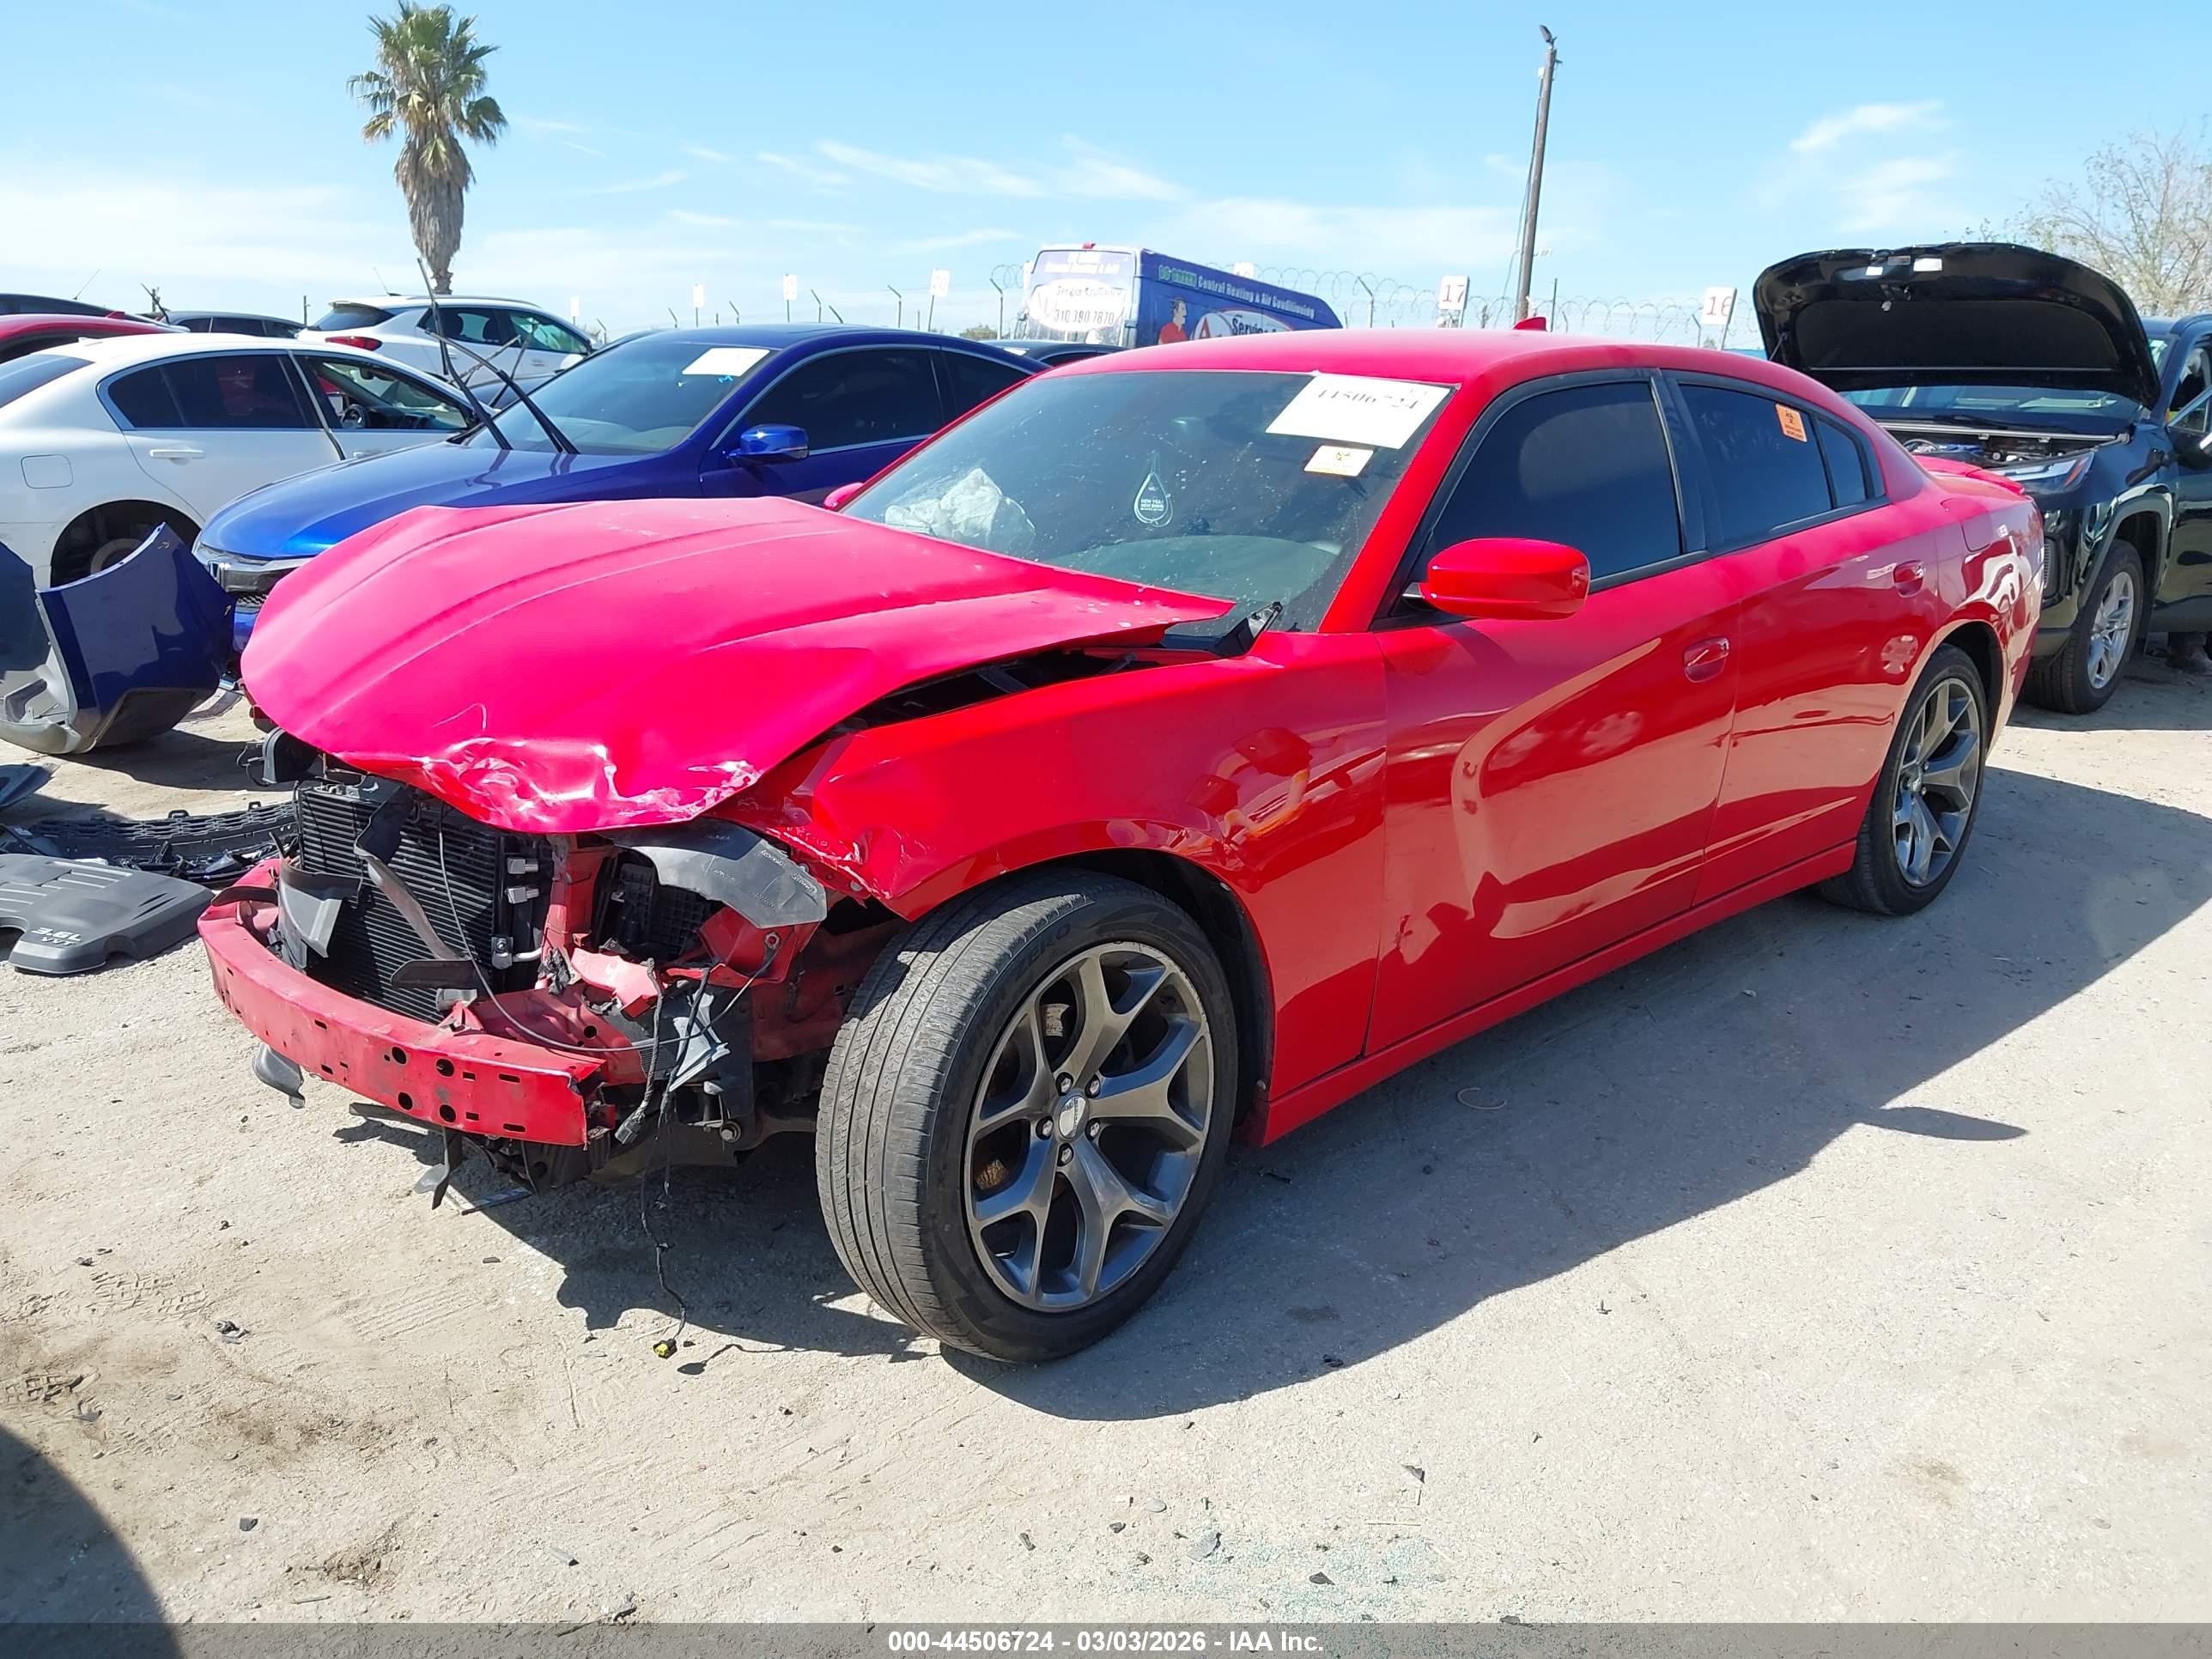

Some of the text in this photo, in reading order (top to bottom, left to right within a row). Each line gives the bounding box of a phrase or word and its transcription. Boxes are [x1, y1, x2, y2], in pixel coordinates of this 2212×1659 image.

[1198, 276, 1225, 294] Central
[1443, 284, 1465, 303] 17
[1706, 295, 1732, 316] 16
[1054, 308, 1071, 324] 310
[1093, 311, 1115, 325] 7870
[31, 927, 82, 942] 3.6L
[42, 937, 76, 945] VVT
